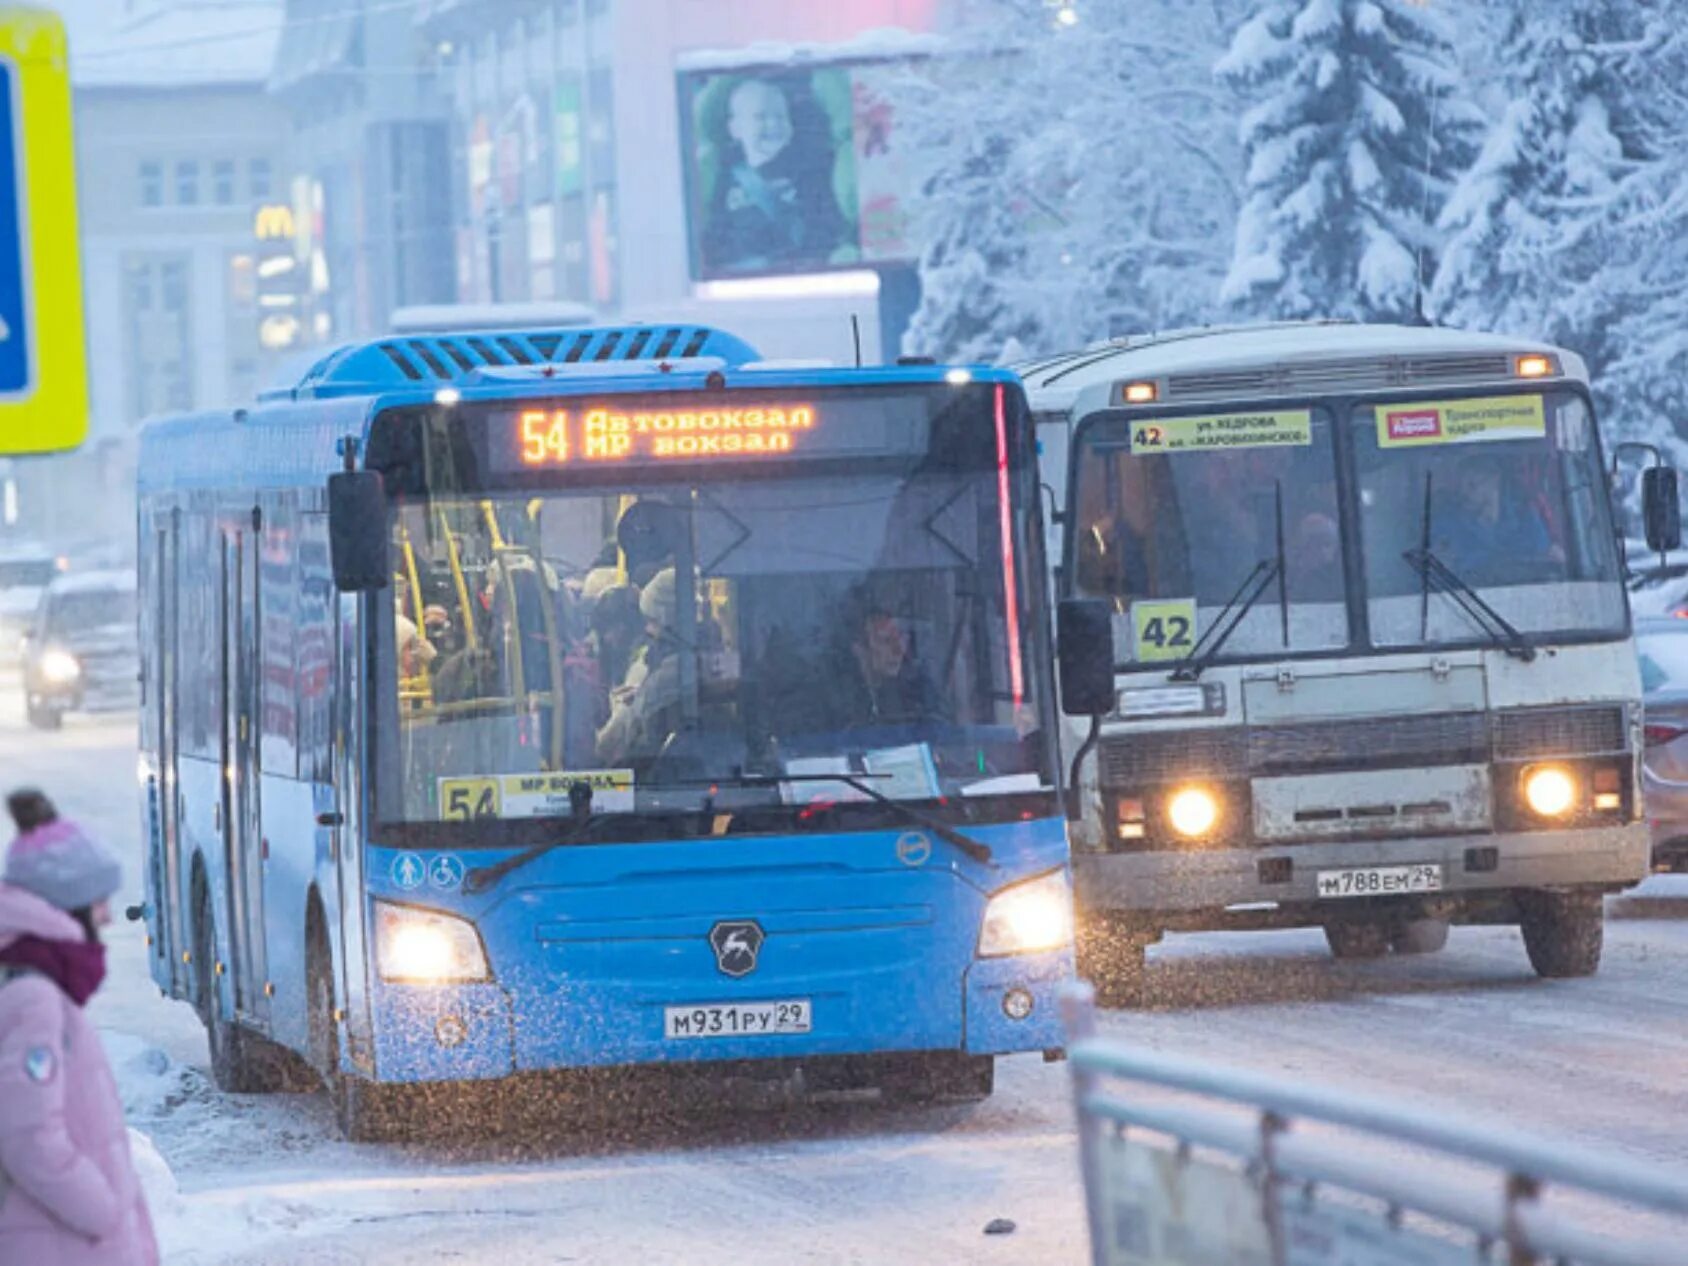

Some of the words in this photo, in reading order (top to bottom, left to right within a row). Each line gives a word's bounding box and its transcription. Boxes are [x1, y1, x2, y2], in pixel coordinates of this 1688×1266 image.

[584, 407, 812, 434] Автовокзал
[521, 411, 567, 463] 54
[584, 432, 630, 458] МР
[654, 430, 791, 456] вокзал
[1134, 427, 1162, 446] 42
[1142, 616, 1192, 648] 42
[449, 786, 498, 821] 54
[778, 1004, 803, 1023] 29
